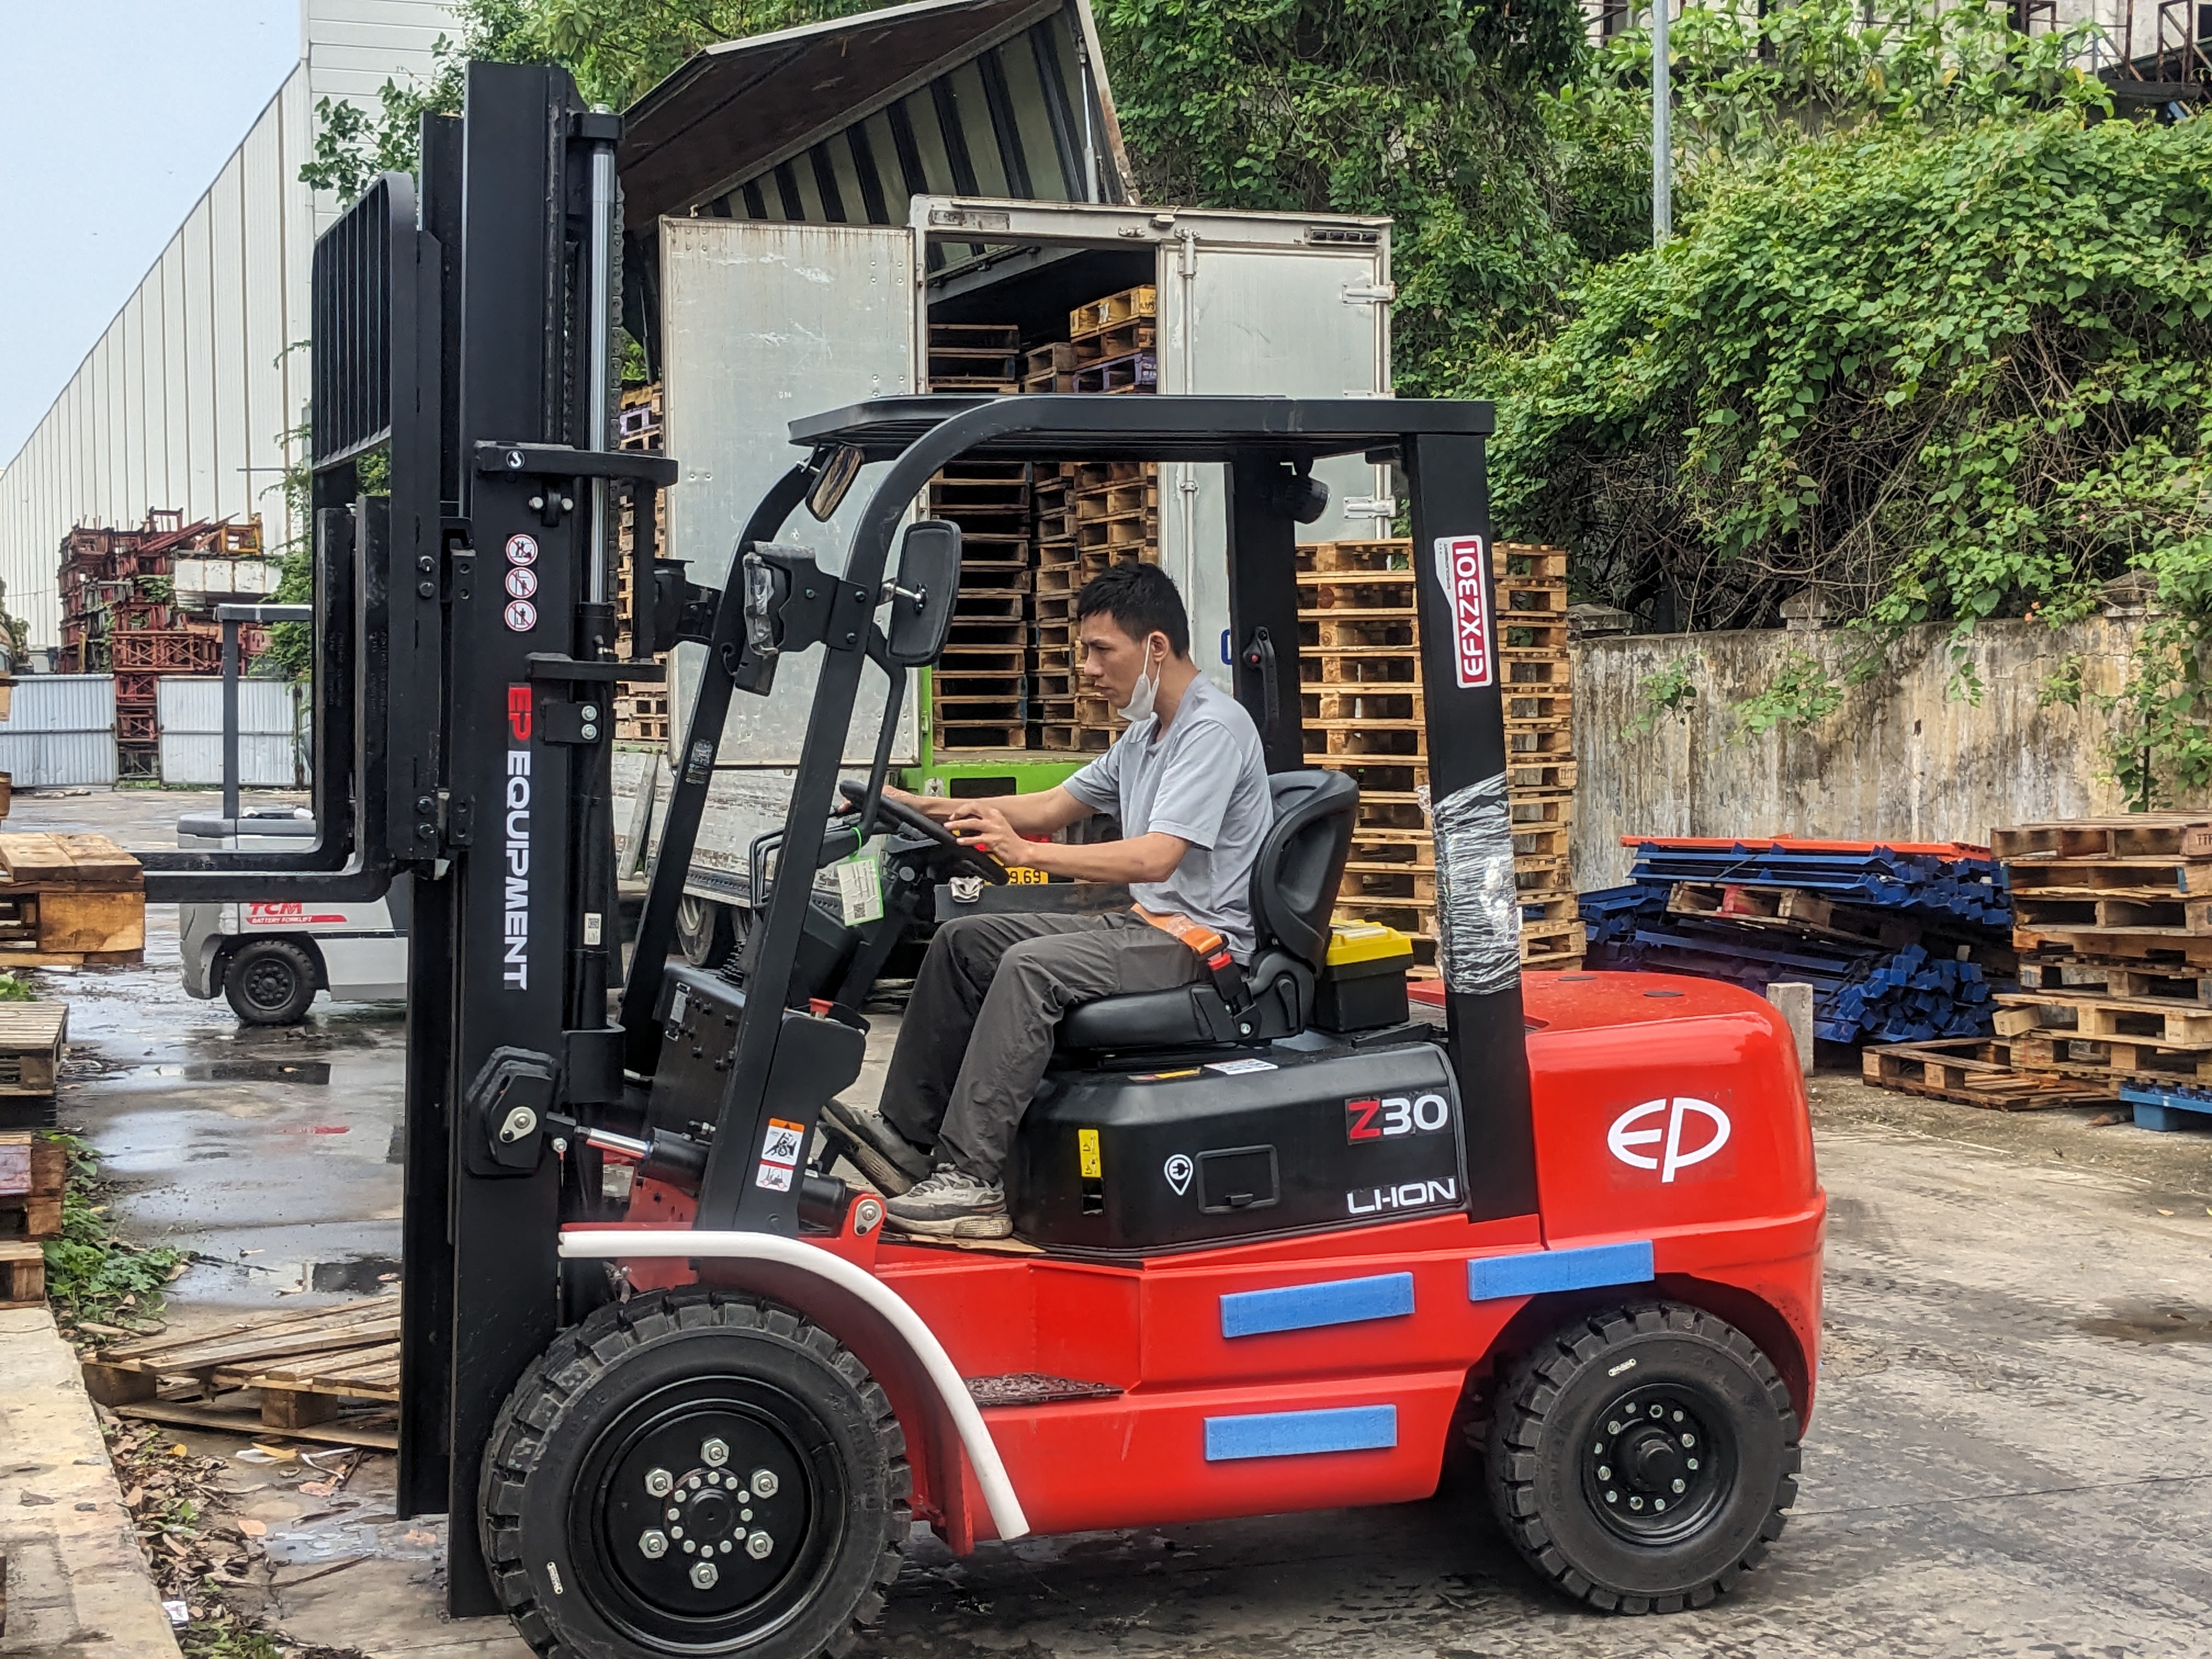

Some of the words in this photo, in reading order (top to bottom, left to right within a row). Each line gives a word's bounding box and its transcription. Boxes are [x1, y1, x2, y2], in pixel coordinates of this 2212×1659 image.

[1455, 547, 1483, 676] EFXZ301
[508, 686, 531, 741] EP
[503, 750, 531, 991] EQUIPMENT
[249, 902, 302, 915] TCM
[1348, 1094, 1448, 1139] Z30
[1607, 1097, 1731, 1183] EP
